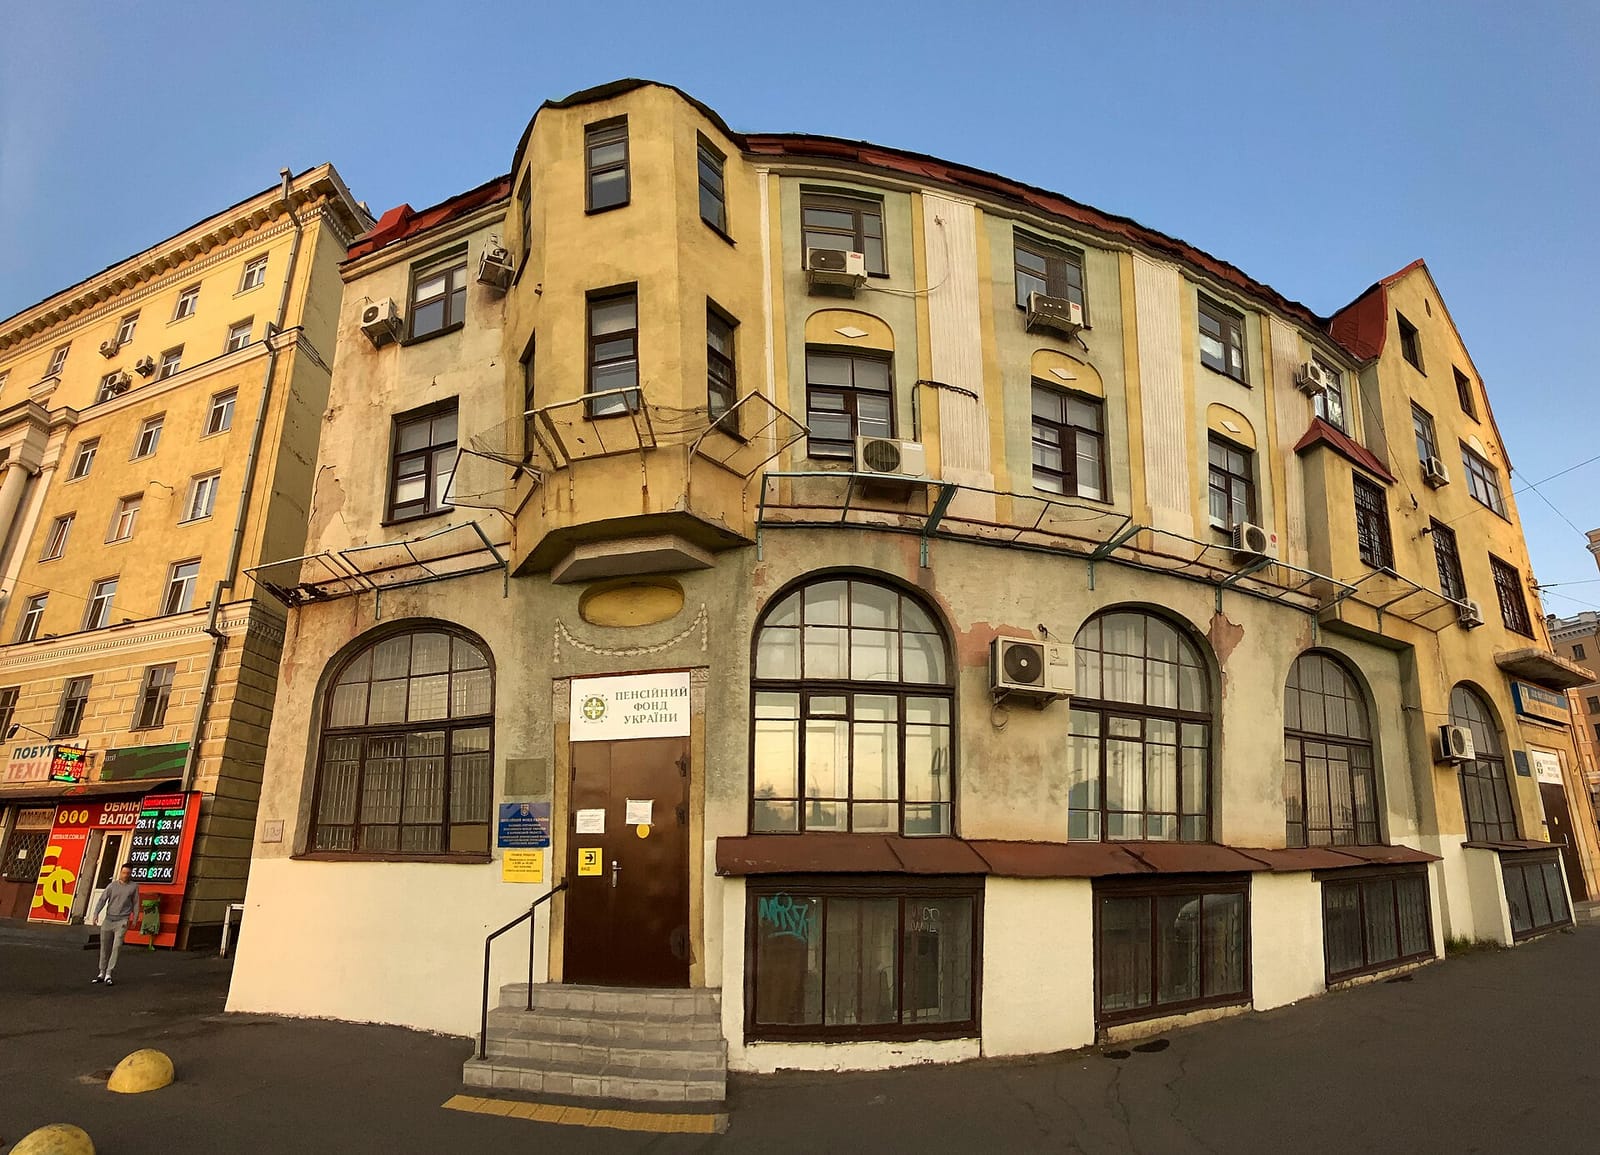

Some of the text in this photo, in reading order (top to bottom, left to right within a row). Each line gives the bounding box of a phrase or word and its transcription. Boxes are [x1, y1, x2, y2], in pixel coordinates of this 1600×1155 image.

[615, 686, 688, 701] ПЕНСІЙНИЙ
[633, 701, 668, 711] ФОНД
[624, 713, 678, 724] УКРАЇНИ
[8, 762, 49, 779] ТЕХН
[136, 819, 156, 829] 28.11
[162, 819, 182, 830] 28.14
[133, 836, 153, 846] 33.11
[130, 868, 147, 878] 5.50
